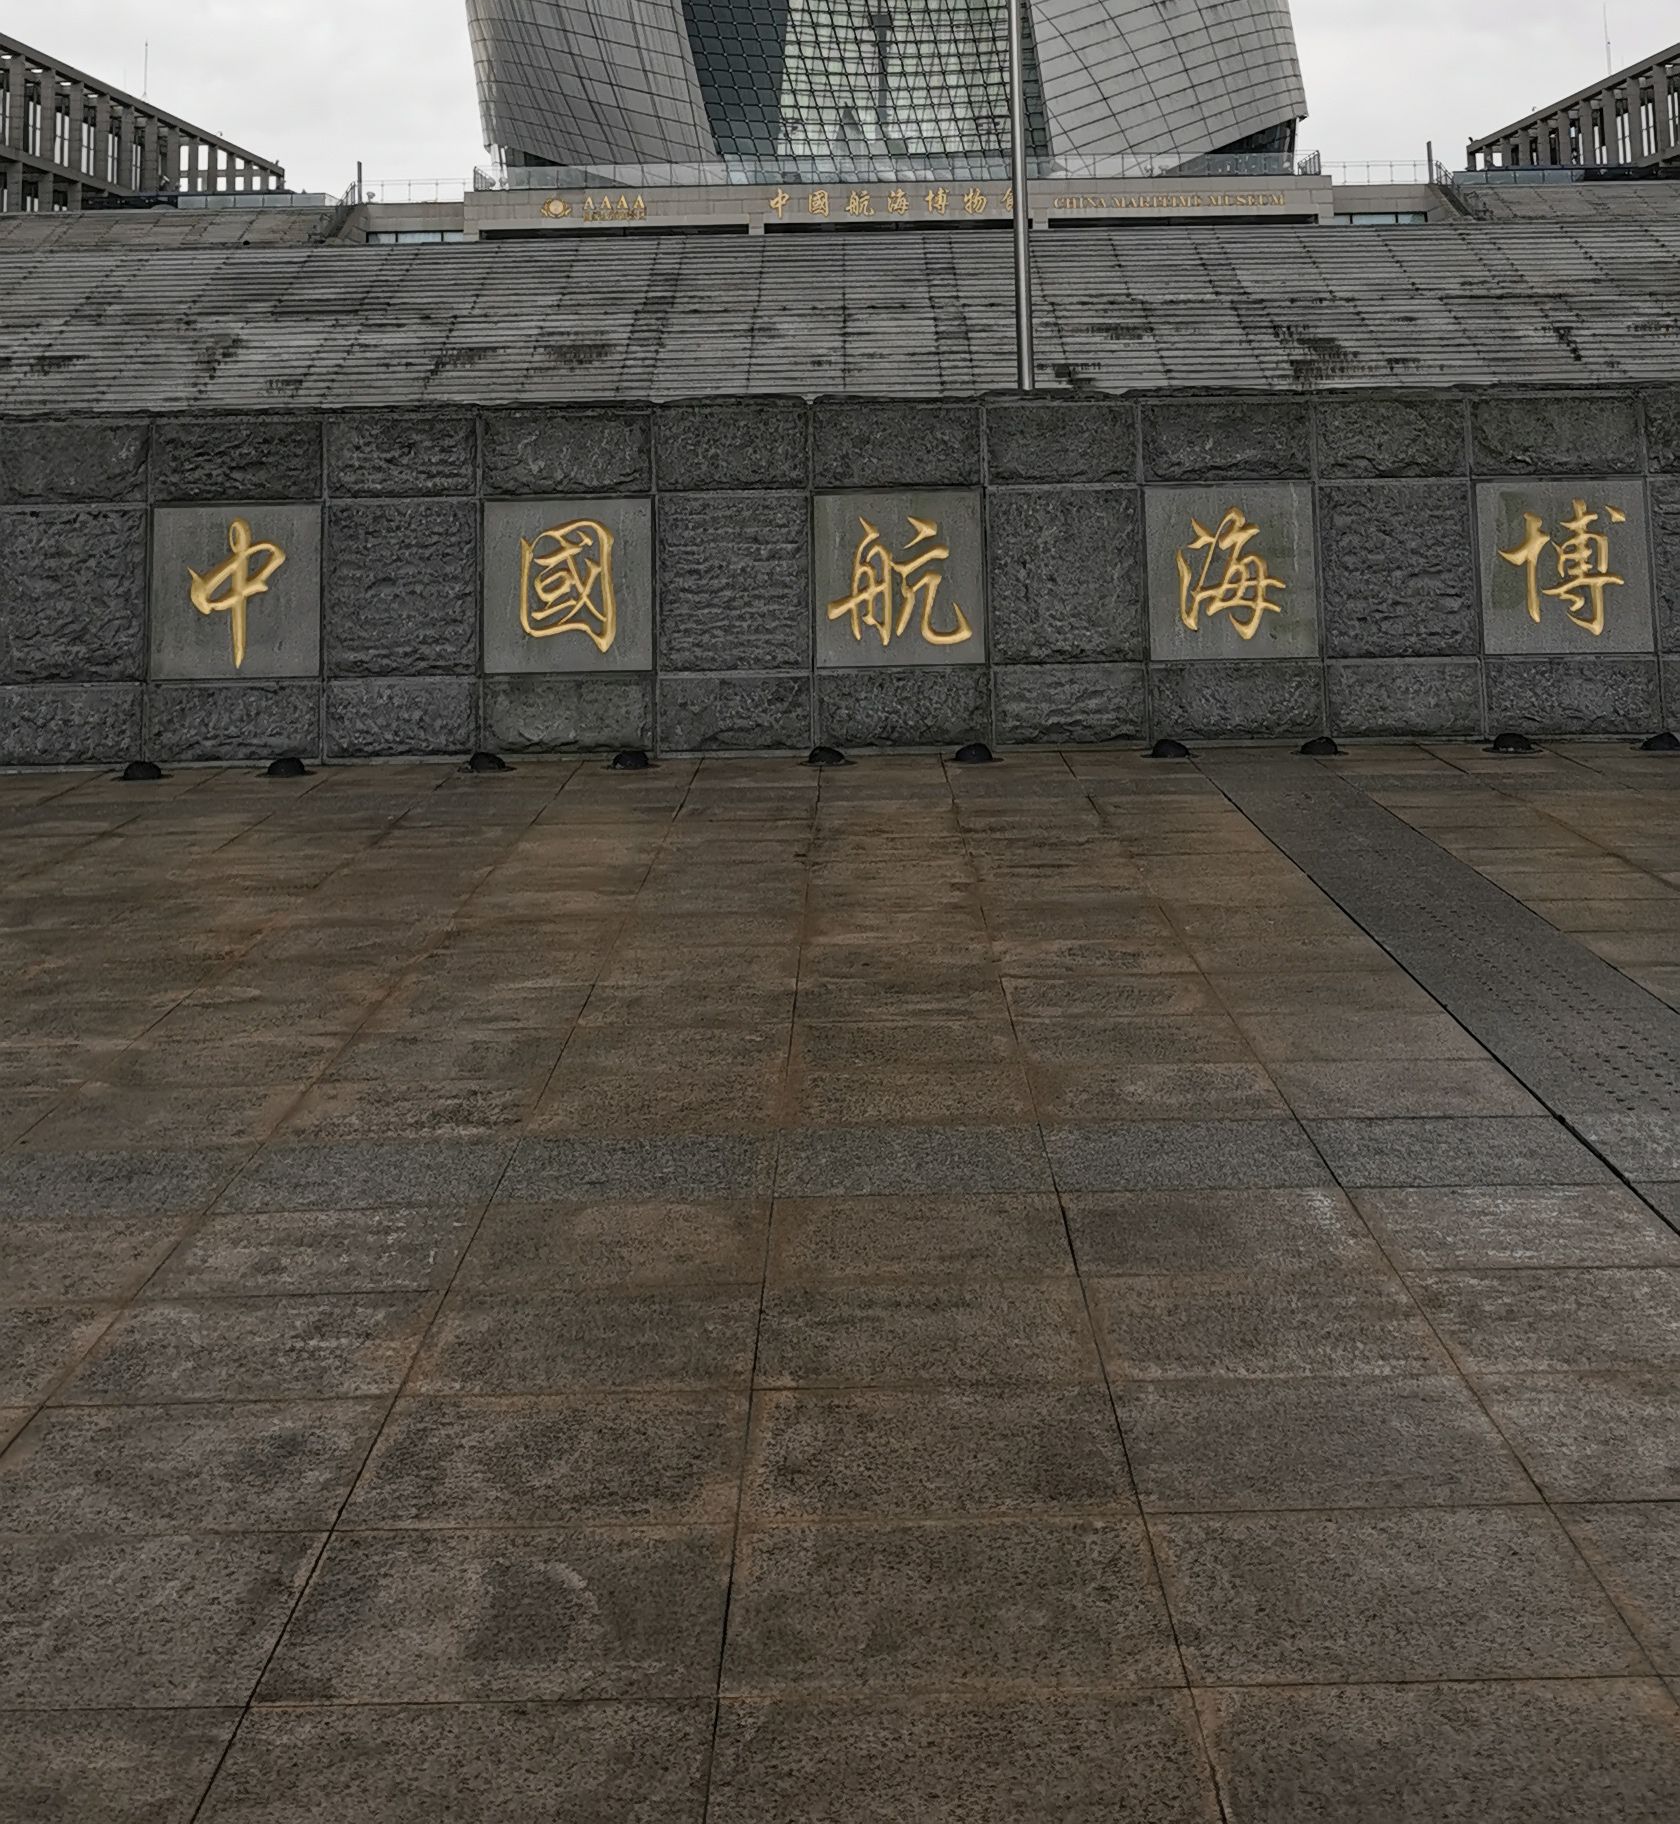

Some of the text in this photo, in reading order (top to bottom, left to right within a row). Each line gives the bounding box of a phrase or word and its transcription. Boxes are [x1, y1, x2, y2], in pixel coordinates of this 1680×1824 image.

[1053, 193, 1286, 209] CHINA MARITIME MUSEUM
